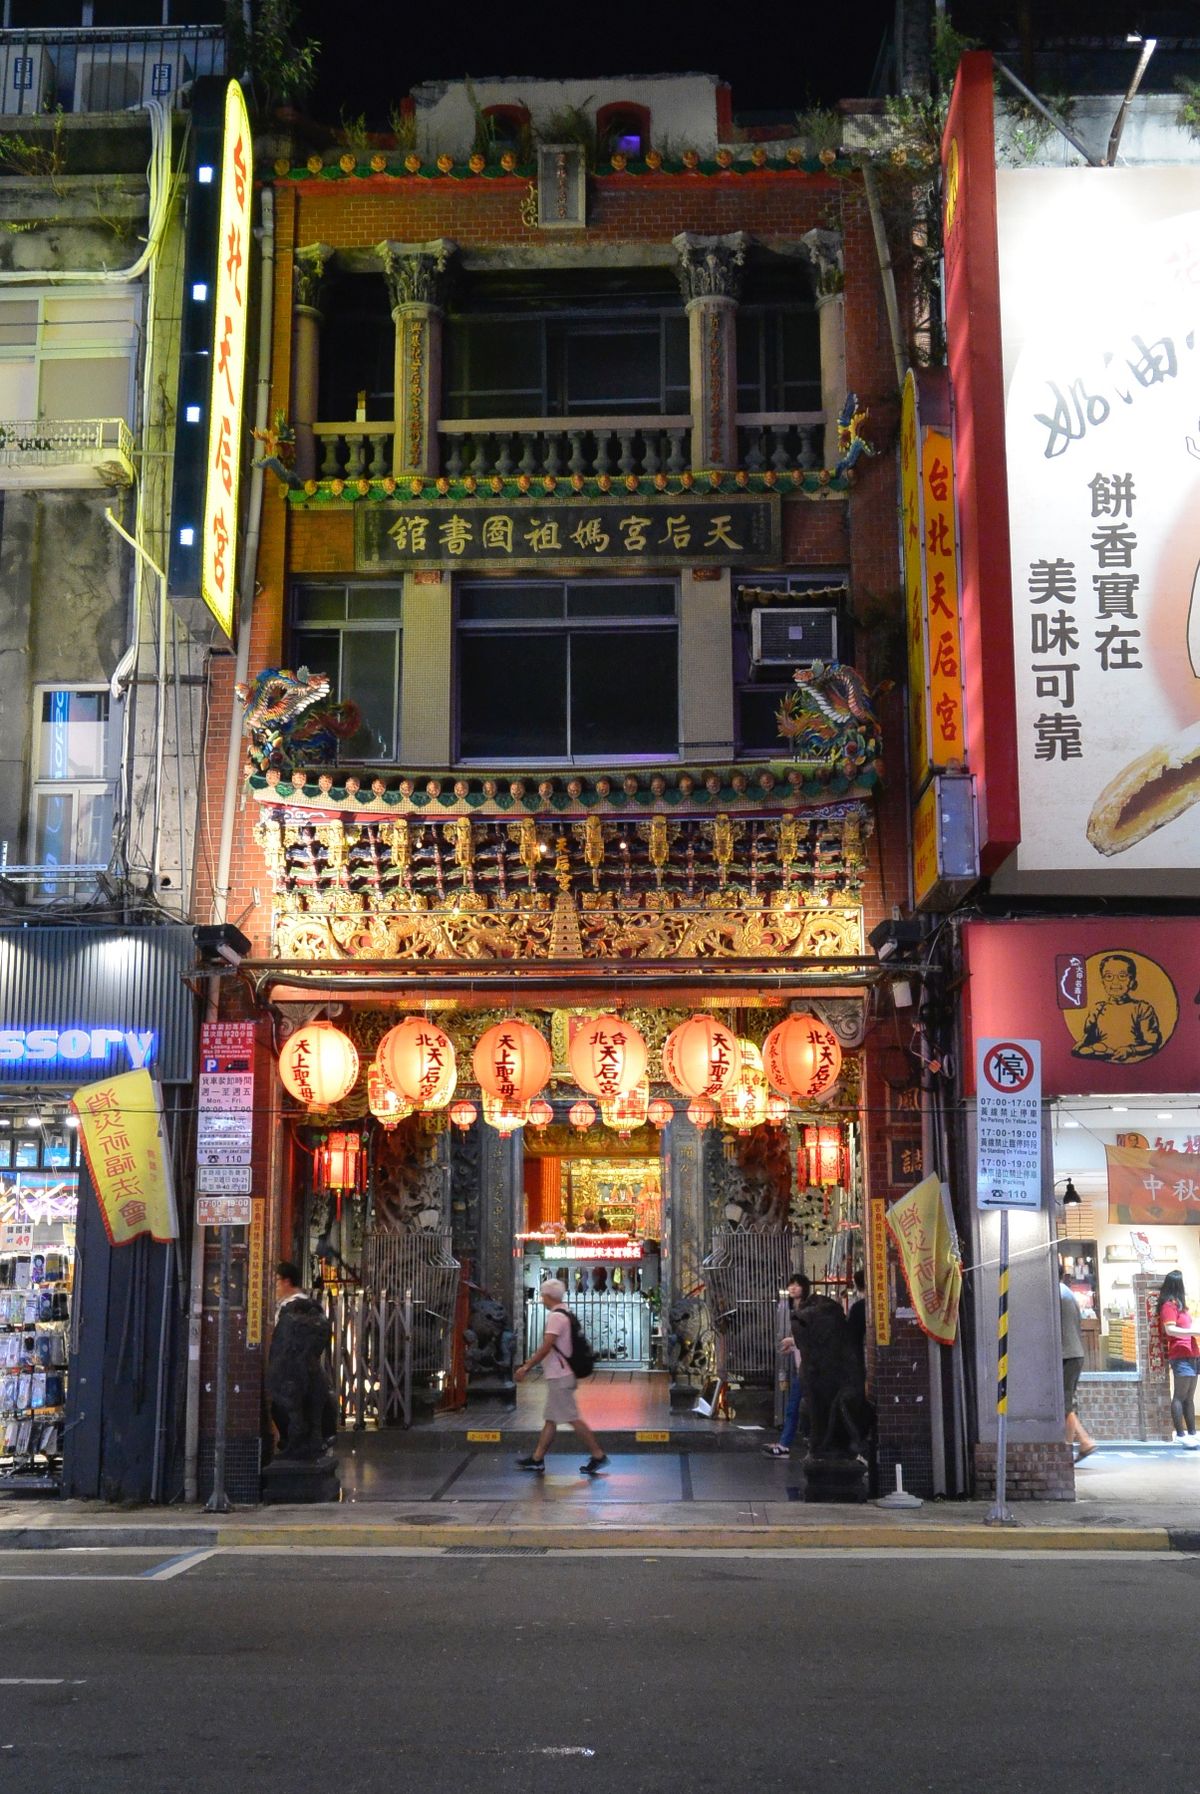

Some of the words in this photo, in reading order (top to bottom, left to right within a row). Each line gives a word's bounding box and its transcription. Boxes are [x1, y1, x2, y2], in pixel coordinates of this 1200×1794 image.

[212, 134, 249, 593] 台北天后宮
[1033, 330, 1195, 460] 奶油
[1088, 472, 1143, 671] 餅香實在
[928, 459, 958, 741] 台北天后宮
[1028, 558, 1083, 761] 美味可靠
[207, 1060, 217, 1072] P
[494, 1035, 520, 1099] 天上聖母
[703, 1033, 731, 1094] 天上聖母
[994, 1054, 1024, 1083] 停
[202, 1077, 252, 1085] 貨車裝卸時間
[202, 1087, 251, 1096] 週一至週五
[981, 1098, 1037, 1107] 07:00-17:00
[981, 1129, 1037, 1138] 17:00-19:00
[981, 1159, 1037, 1168] 17:00-19:00
[1143, 1174, 1200, 1202] 中秋
[16, 1235, 30, 1246] 49
